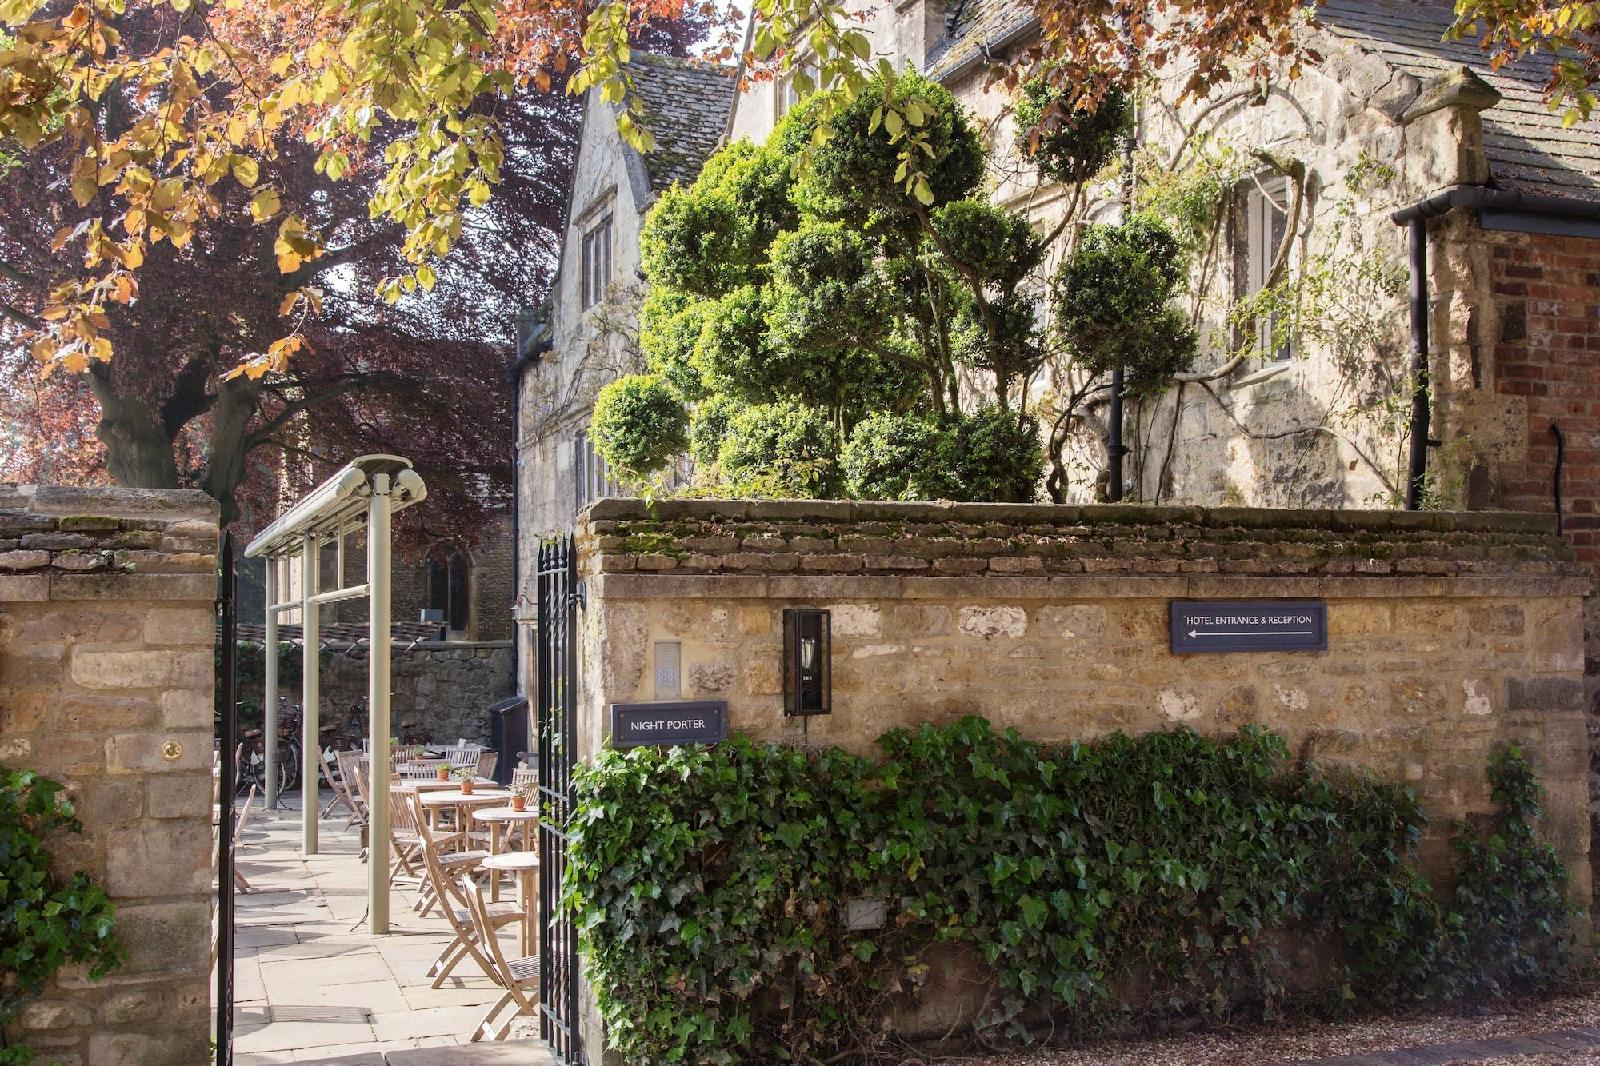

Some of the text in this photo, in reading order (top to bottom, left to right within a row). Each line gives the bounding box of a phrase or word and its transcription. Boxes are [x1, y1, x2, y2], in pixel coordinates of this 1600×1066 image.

[1186, 616, 1312, 625] HOTEL ENTRANCE & RECEPTION
[631, 719, 705, 730] NIGHT PORTER
